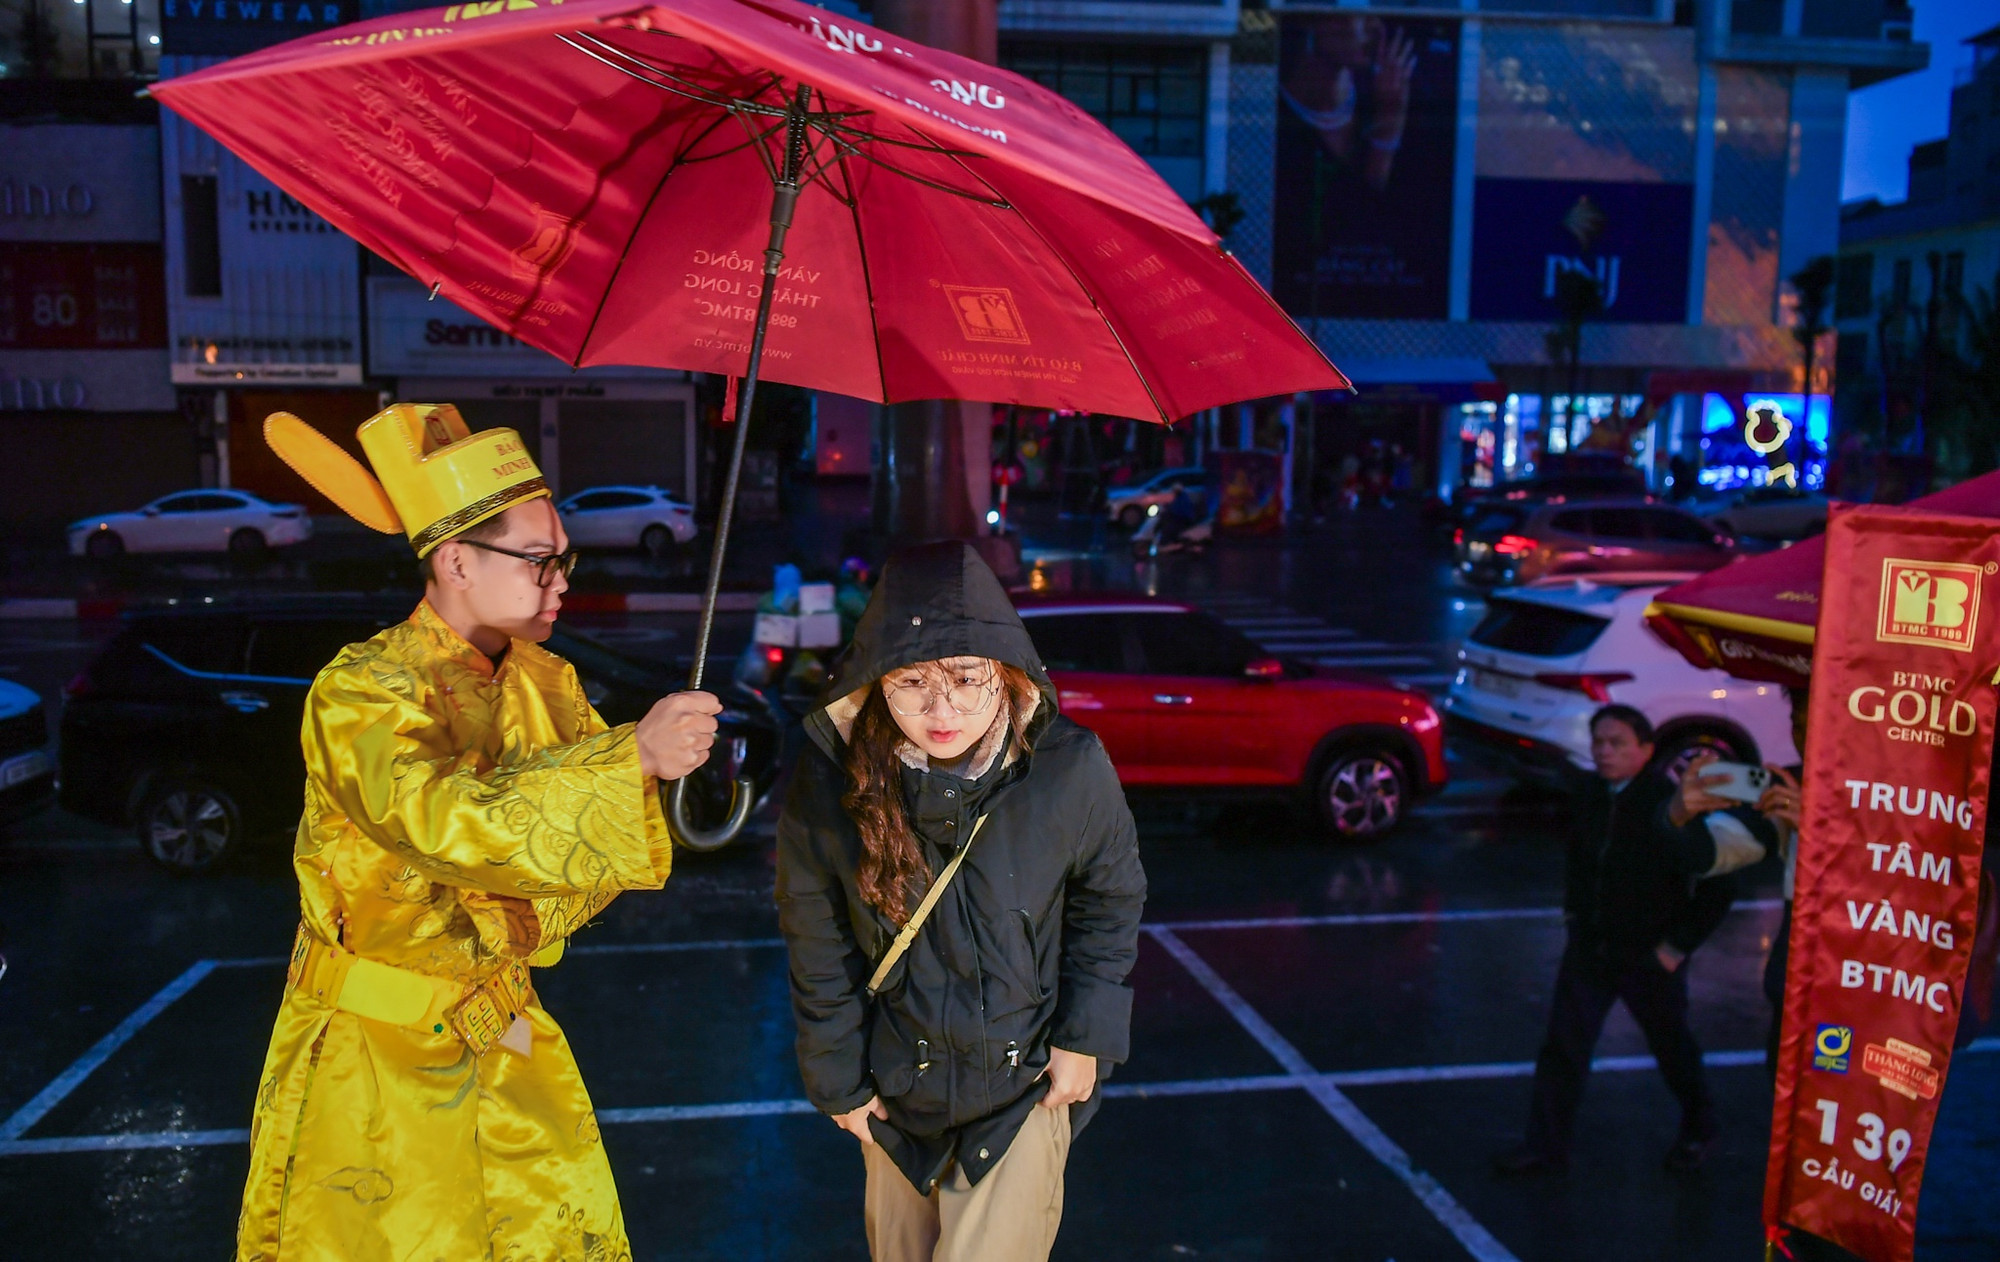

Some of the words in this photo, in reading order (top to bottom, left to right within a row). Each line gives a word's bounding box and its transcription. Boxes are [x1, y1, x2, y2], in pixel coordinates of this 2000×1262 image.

[164, 0, 341, 24] EYEWEAR
[32, 292, 76, 328] 80
[492, 457, 532, 480] MINH
[1892, 624, 1929, 636] BTMC
[1934, 628, 1963, 641] 1989
[1893, 671, 1956, 694] BTMC
[1848, 686, 1977, 737] GOLD
[1887, 726, 1945, 748] CENTER
[1845, 779, 1974, 831] TRUNG
[1866, 842, 1952, 886] TÂM
[1846, 899, 1954, 950] VÀNG
[1840, 959, 1949, 1013] BTMC
[1802, 1156, 1855, 1190] CẦU
[1859, 1180, 1902, 1218] GIẤY
